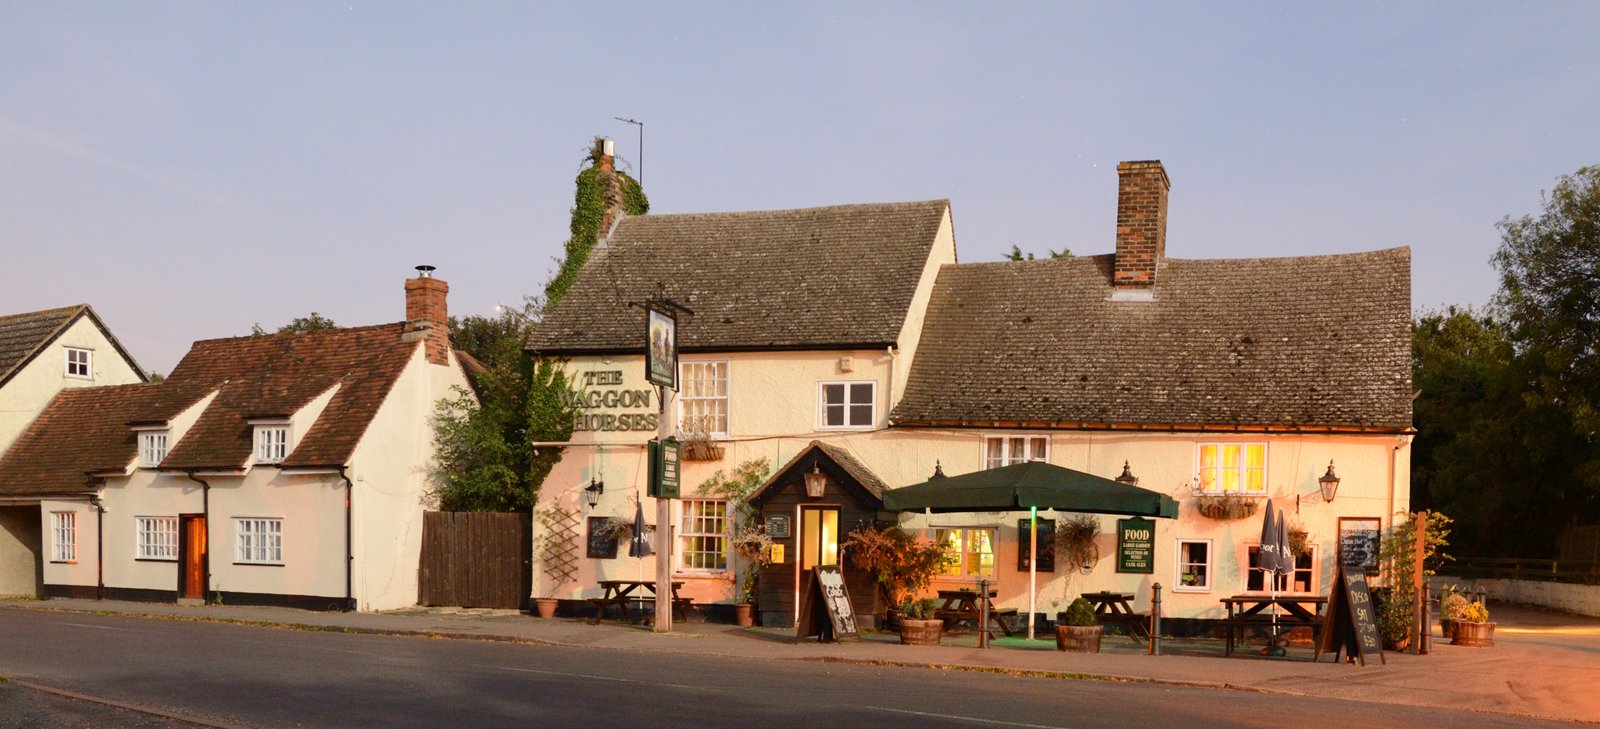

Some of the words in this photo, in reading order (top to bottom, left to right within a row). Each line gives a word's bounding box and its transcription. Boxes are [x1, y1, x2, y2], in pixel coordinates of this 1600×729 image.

[584, 370, 622, 385] THE
[560, 390, 651, 408] WAGGON
[573, 413, 658, 431] HORSES
[1125, 529, 1149, 540] FOOD
[1351, 590, 1368, 604] DISCO
